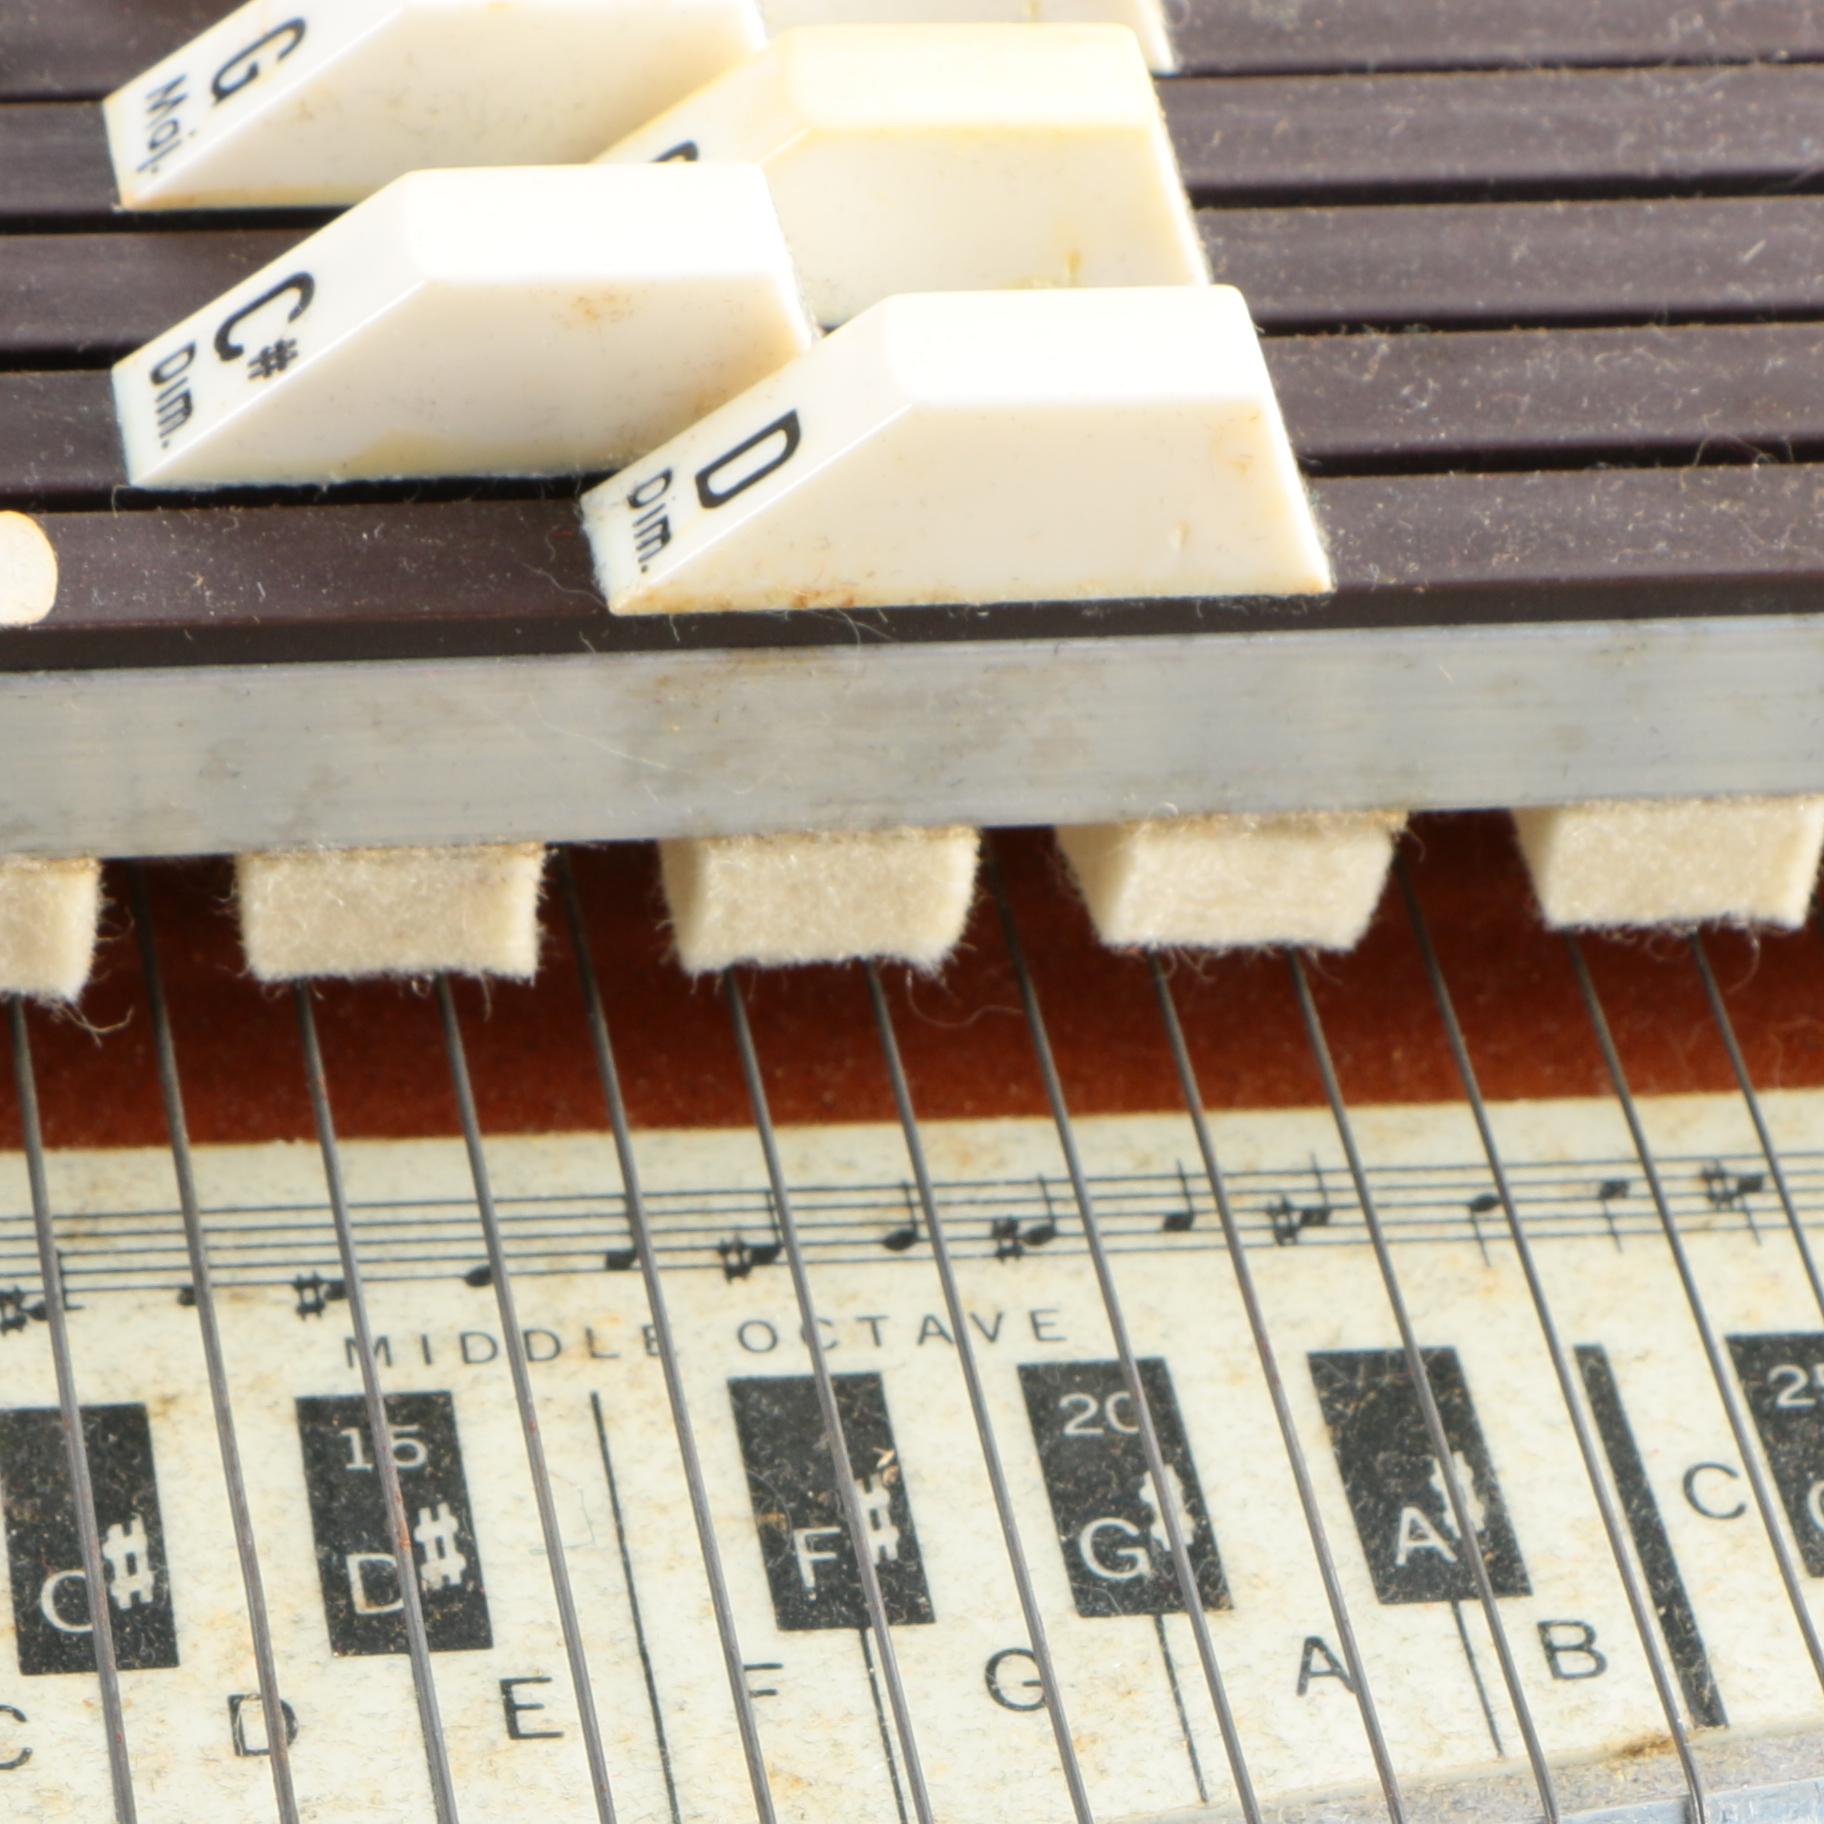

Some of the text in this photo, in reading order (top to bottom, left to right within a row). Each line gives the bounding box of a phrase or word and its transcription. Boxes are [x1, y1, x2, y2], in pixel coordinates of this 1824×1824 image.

[211, 17, 306, 107] G
[214, 271, 315, 380] C#
[695, 408, 801, 508] D
[738, 1308, 1068, 1354] OCTAVE
[1683, 1463, 1747, 1520] C
[229, 1694, 298, 1756] D
[500, 1677, 564, 1740] E
[985, 1648, 1048, 1712] G
[1297, 1637, 1356, 1697] A
[1538, 1621, 1607, 1681] B
